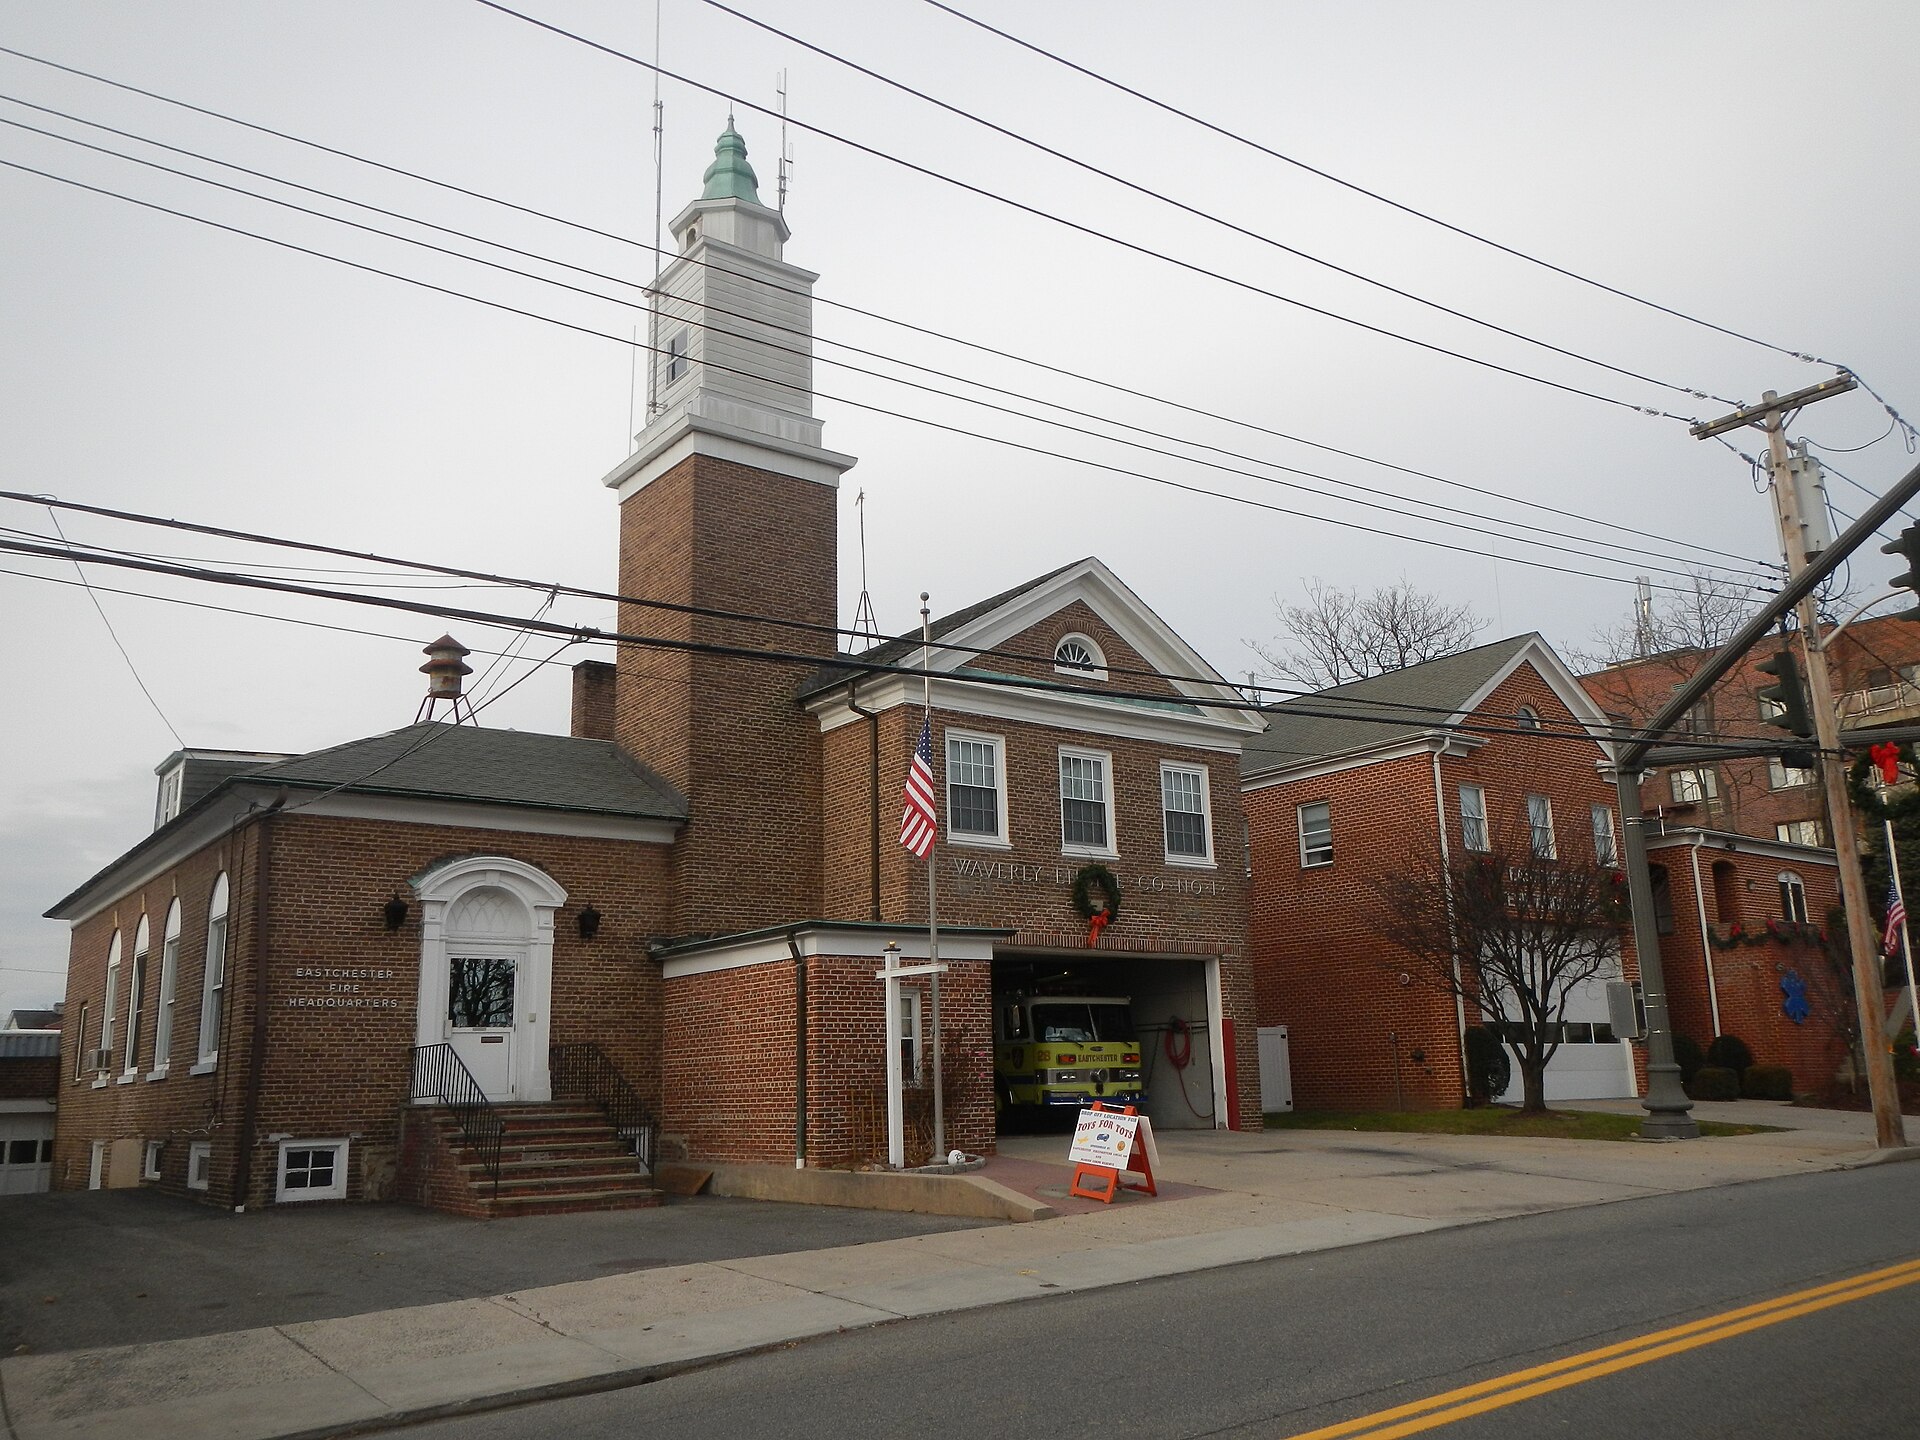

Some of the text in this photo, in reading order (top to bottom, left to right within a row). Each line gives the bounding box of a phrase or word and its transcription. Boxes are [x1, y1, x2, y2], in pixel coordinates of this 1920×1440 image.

[954, 858, 1042, 882] WAVERLY
[296, 967, 393, 979] EASTCHESTER
[330, 983, 360, 993] FIRE
[289, 997, 398, 1008] HEADQUARTERS
[1078, 1054, 1118, 1063] EASTCHESTER
[1078, 1119, 1134, 1139] TOYS FOR TOTS
